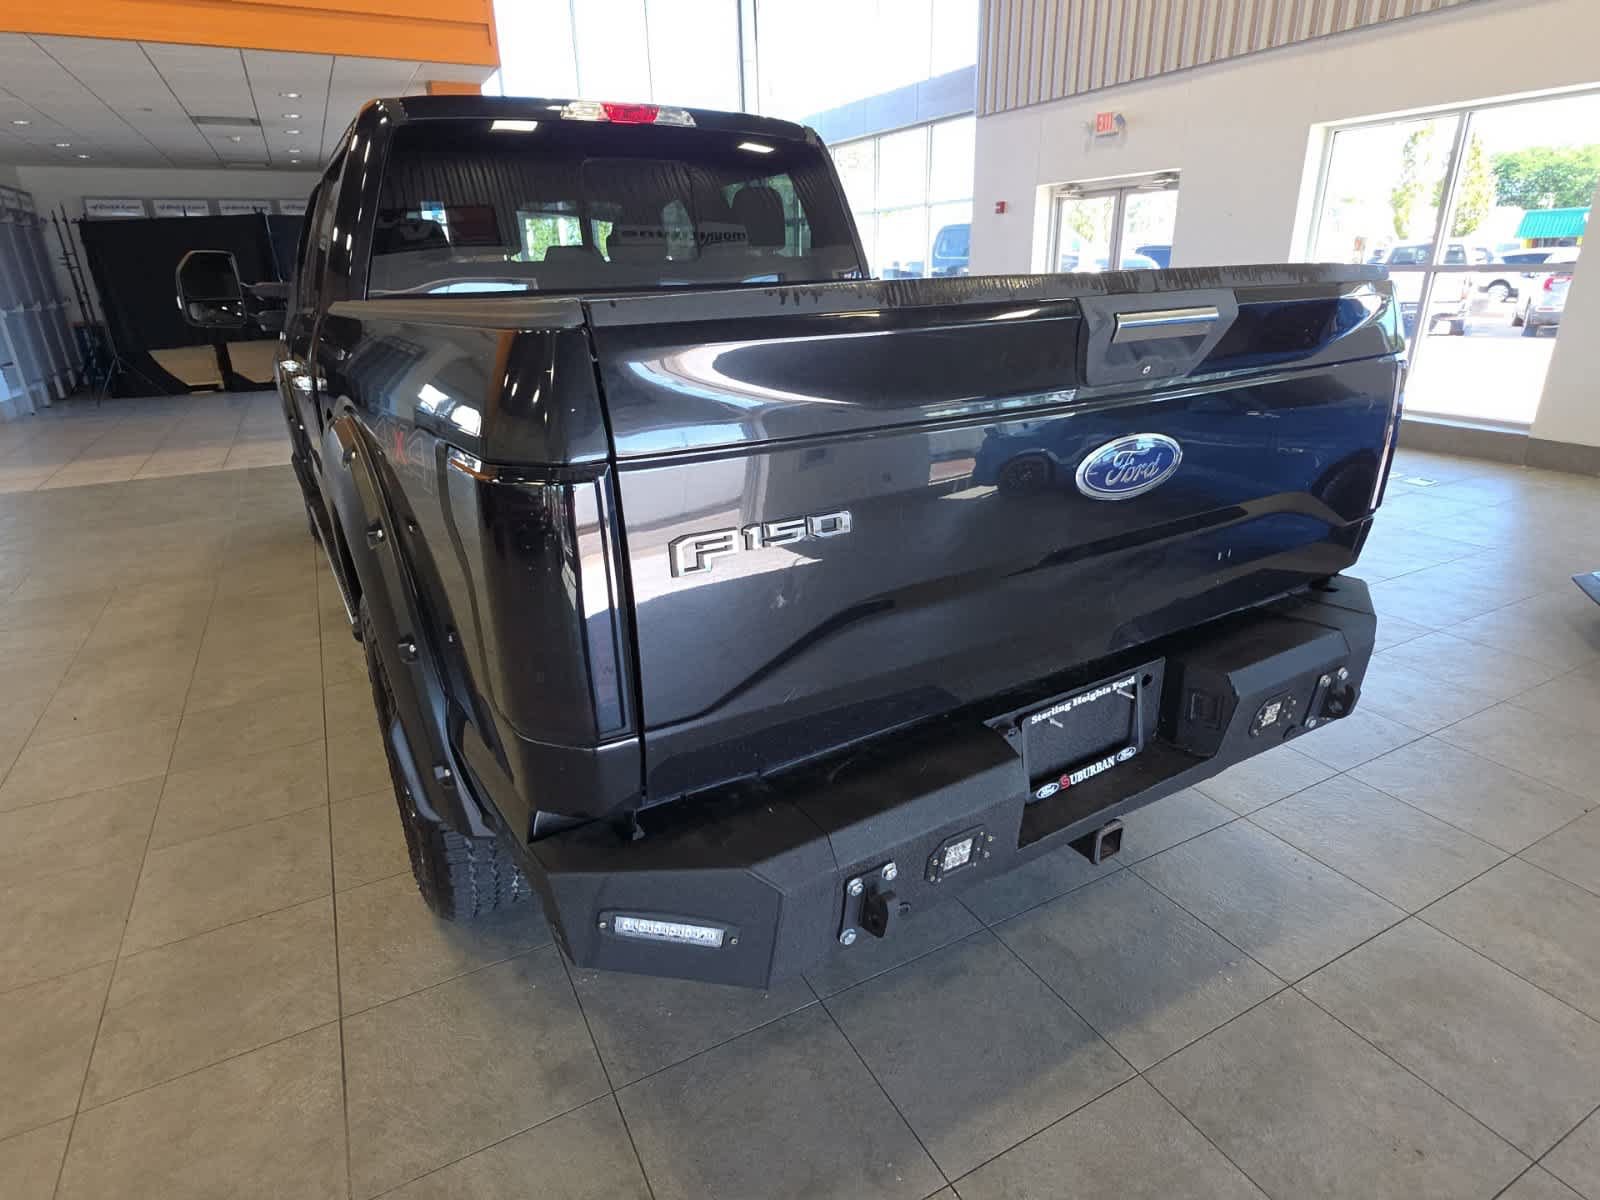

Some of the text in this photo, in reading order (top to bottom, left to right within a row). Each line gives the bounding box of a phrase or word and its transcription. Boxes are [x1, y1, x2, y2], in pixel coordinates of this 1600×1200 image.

[1105, 447, 1162, 486] Ford
[1031, 675, 1136, 724] Sterling Heights Ford
[1060, 755, 1115, 790] SUBURBAN
